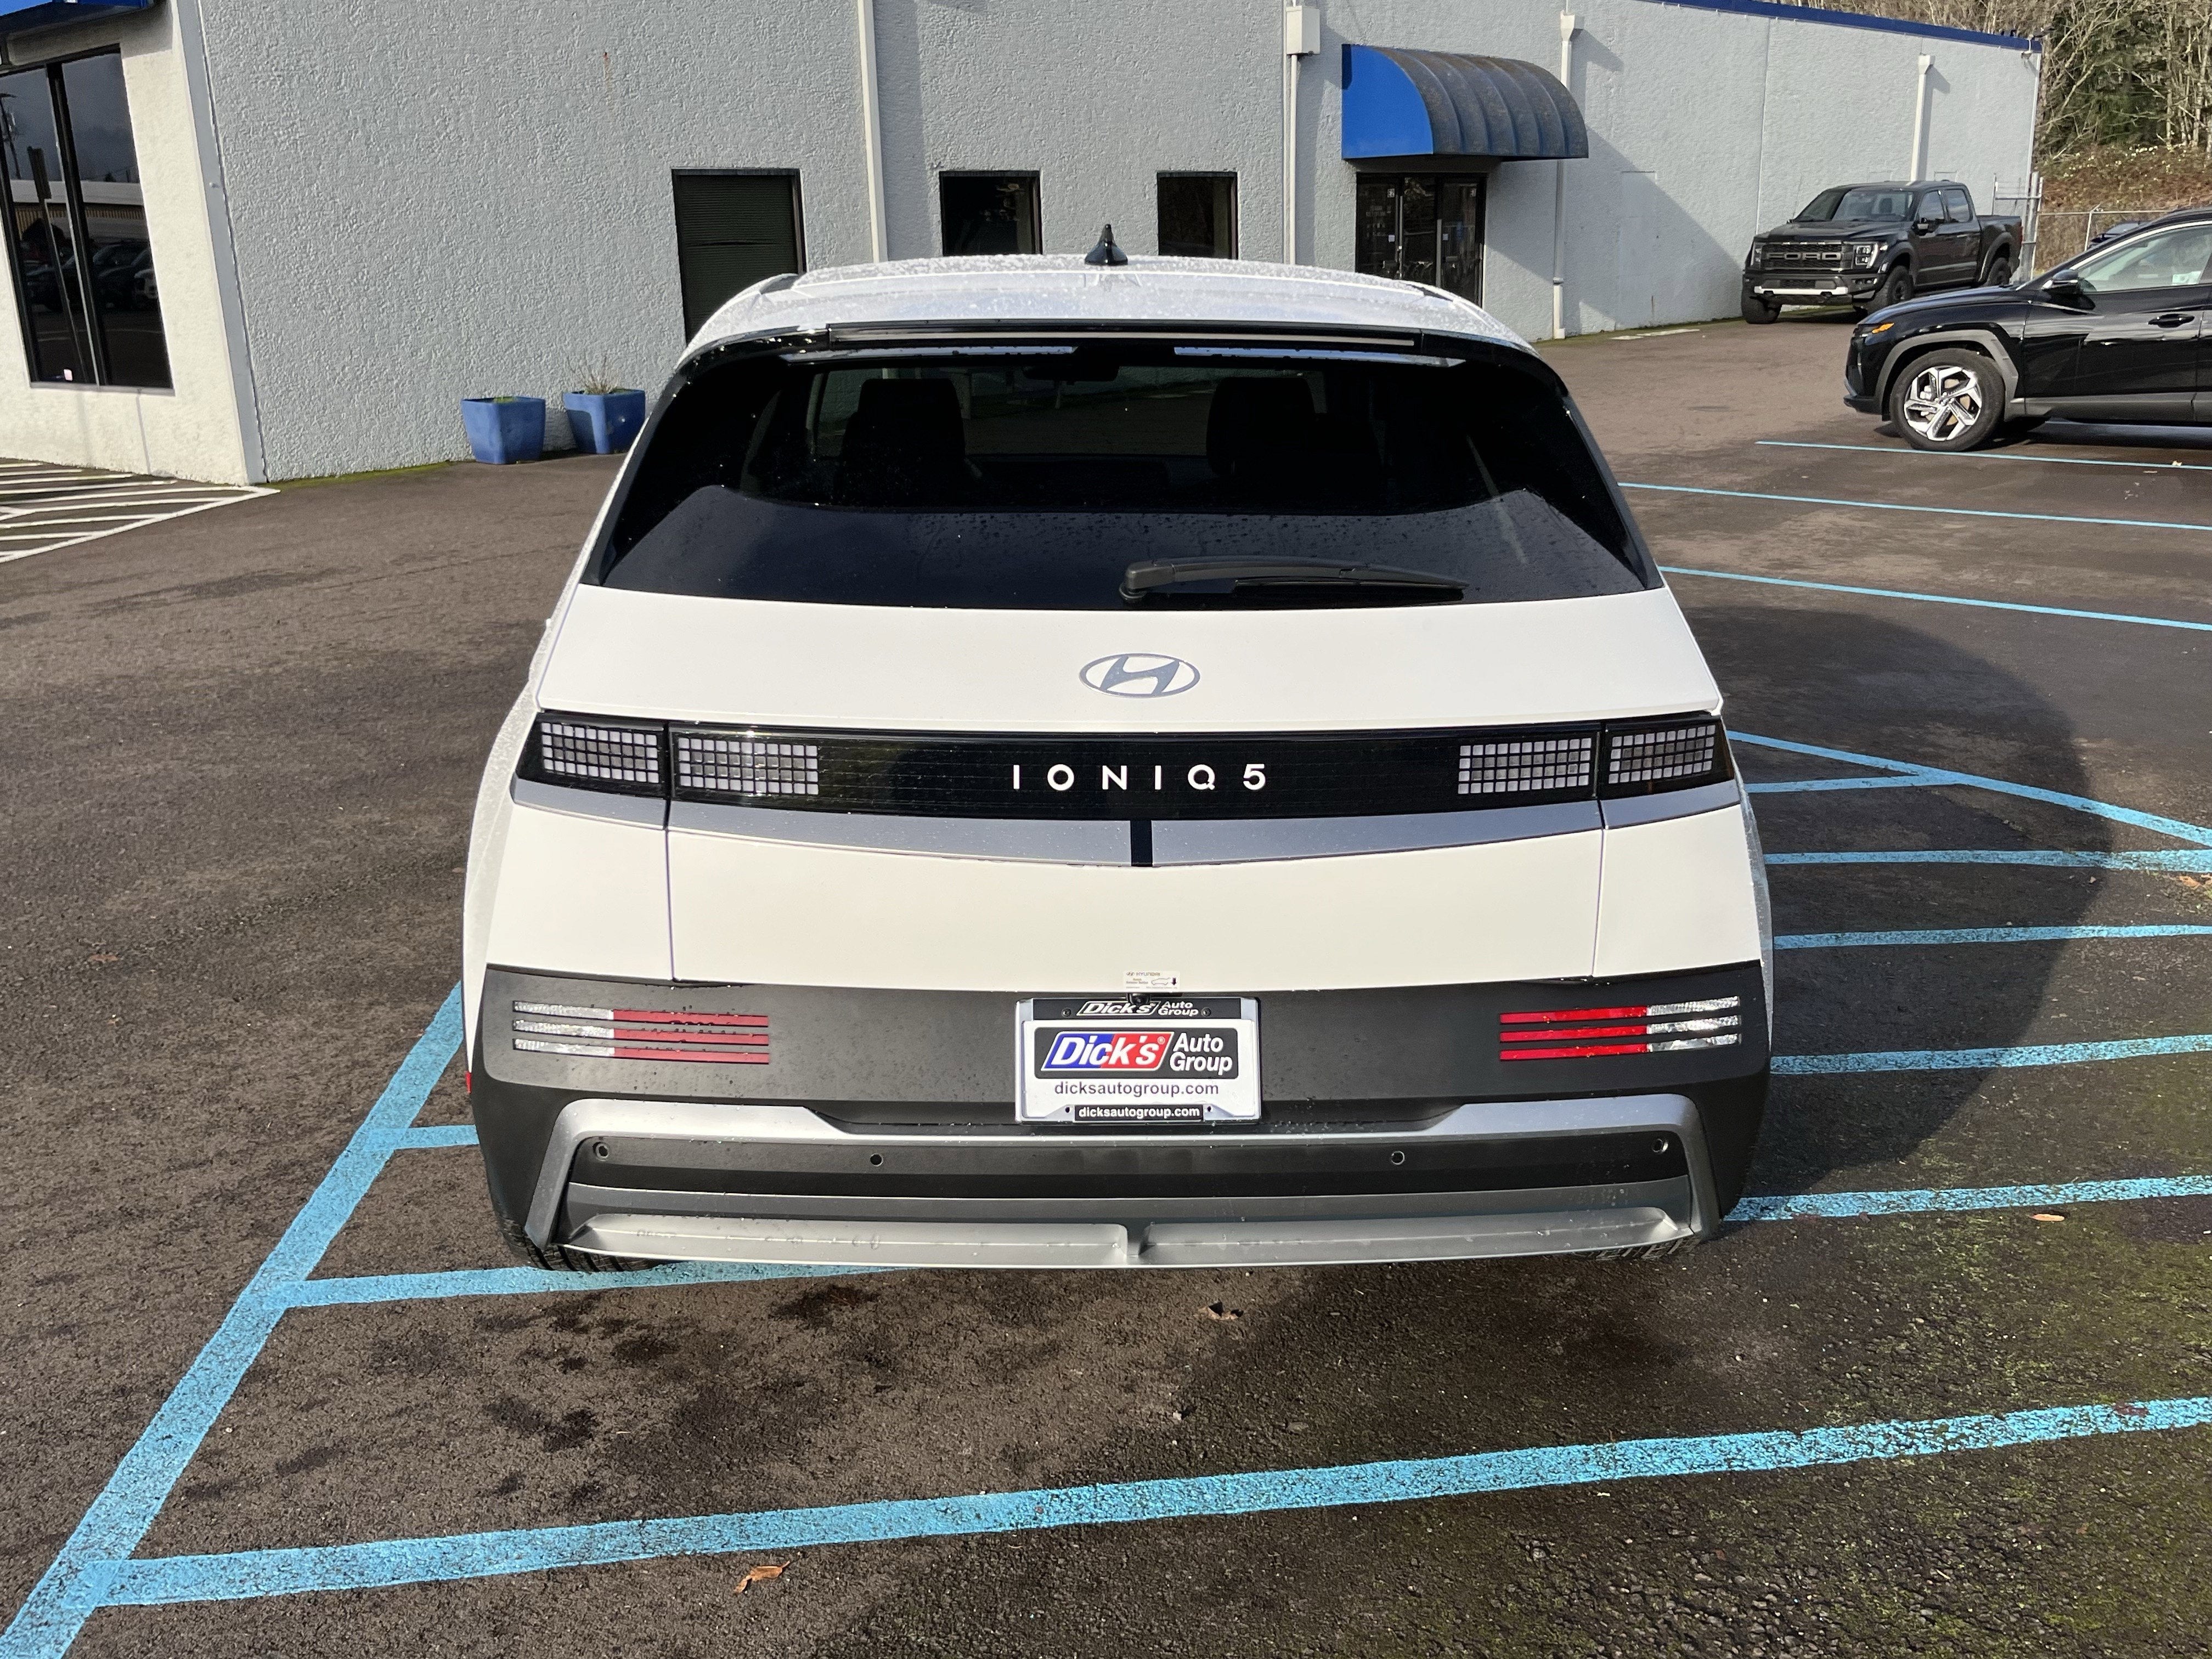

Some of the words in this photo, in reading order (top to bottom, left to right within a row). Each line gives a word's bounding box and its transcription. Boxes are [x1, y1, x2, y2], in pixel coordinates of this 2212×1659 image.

[1084, 1002, 1151, 1014] Dicks
[1158, 1008, 1199, 1017] Group
[1173, 1033, 1223, 1052] Auto
[1170, 1052, 1233, 1075] Group
[1054, 1081, 1218, 1097] dicksautogroup.com
[1079, 1107, 1200, 1119] dicksautogroup.com
